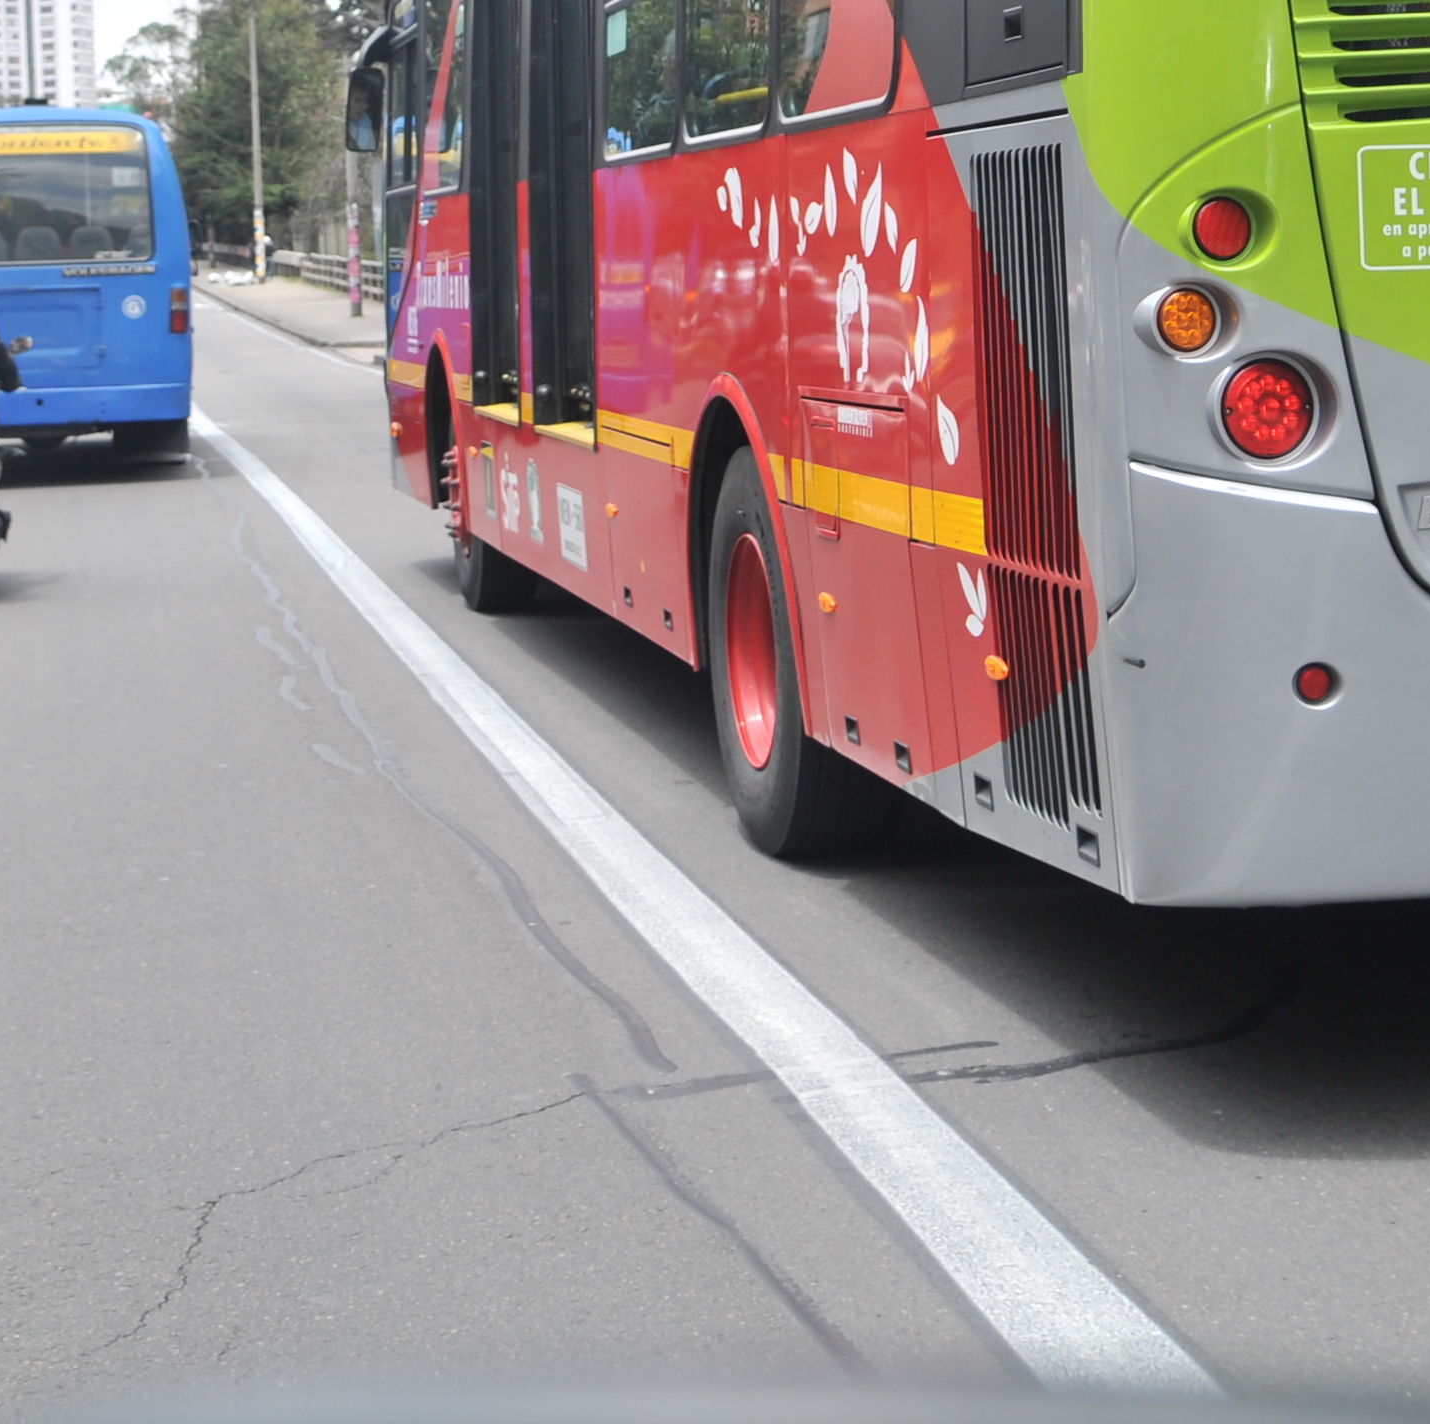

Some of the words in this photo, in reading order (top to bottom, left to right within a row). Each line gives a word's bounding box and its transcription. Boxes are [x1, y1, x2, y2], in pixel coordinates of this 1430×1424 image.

[1394, 187, 1424, 216] EL
[1382, 224, 1402, 236] en
[1402, 245, 1411, 257] a
